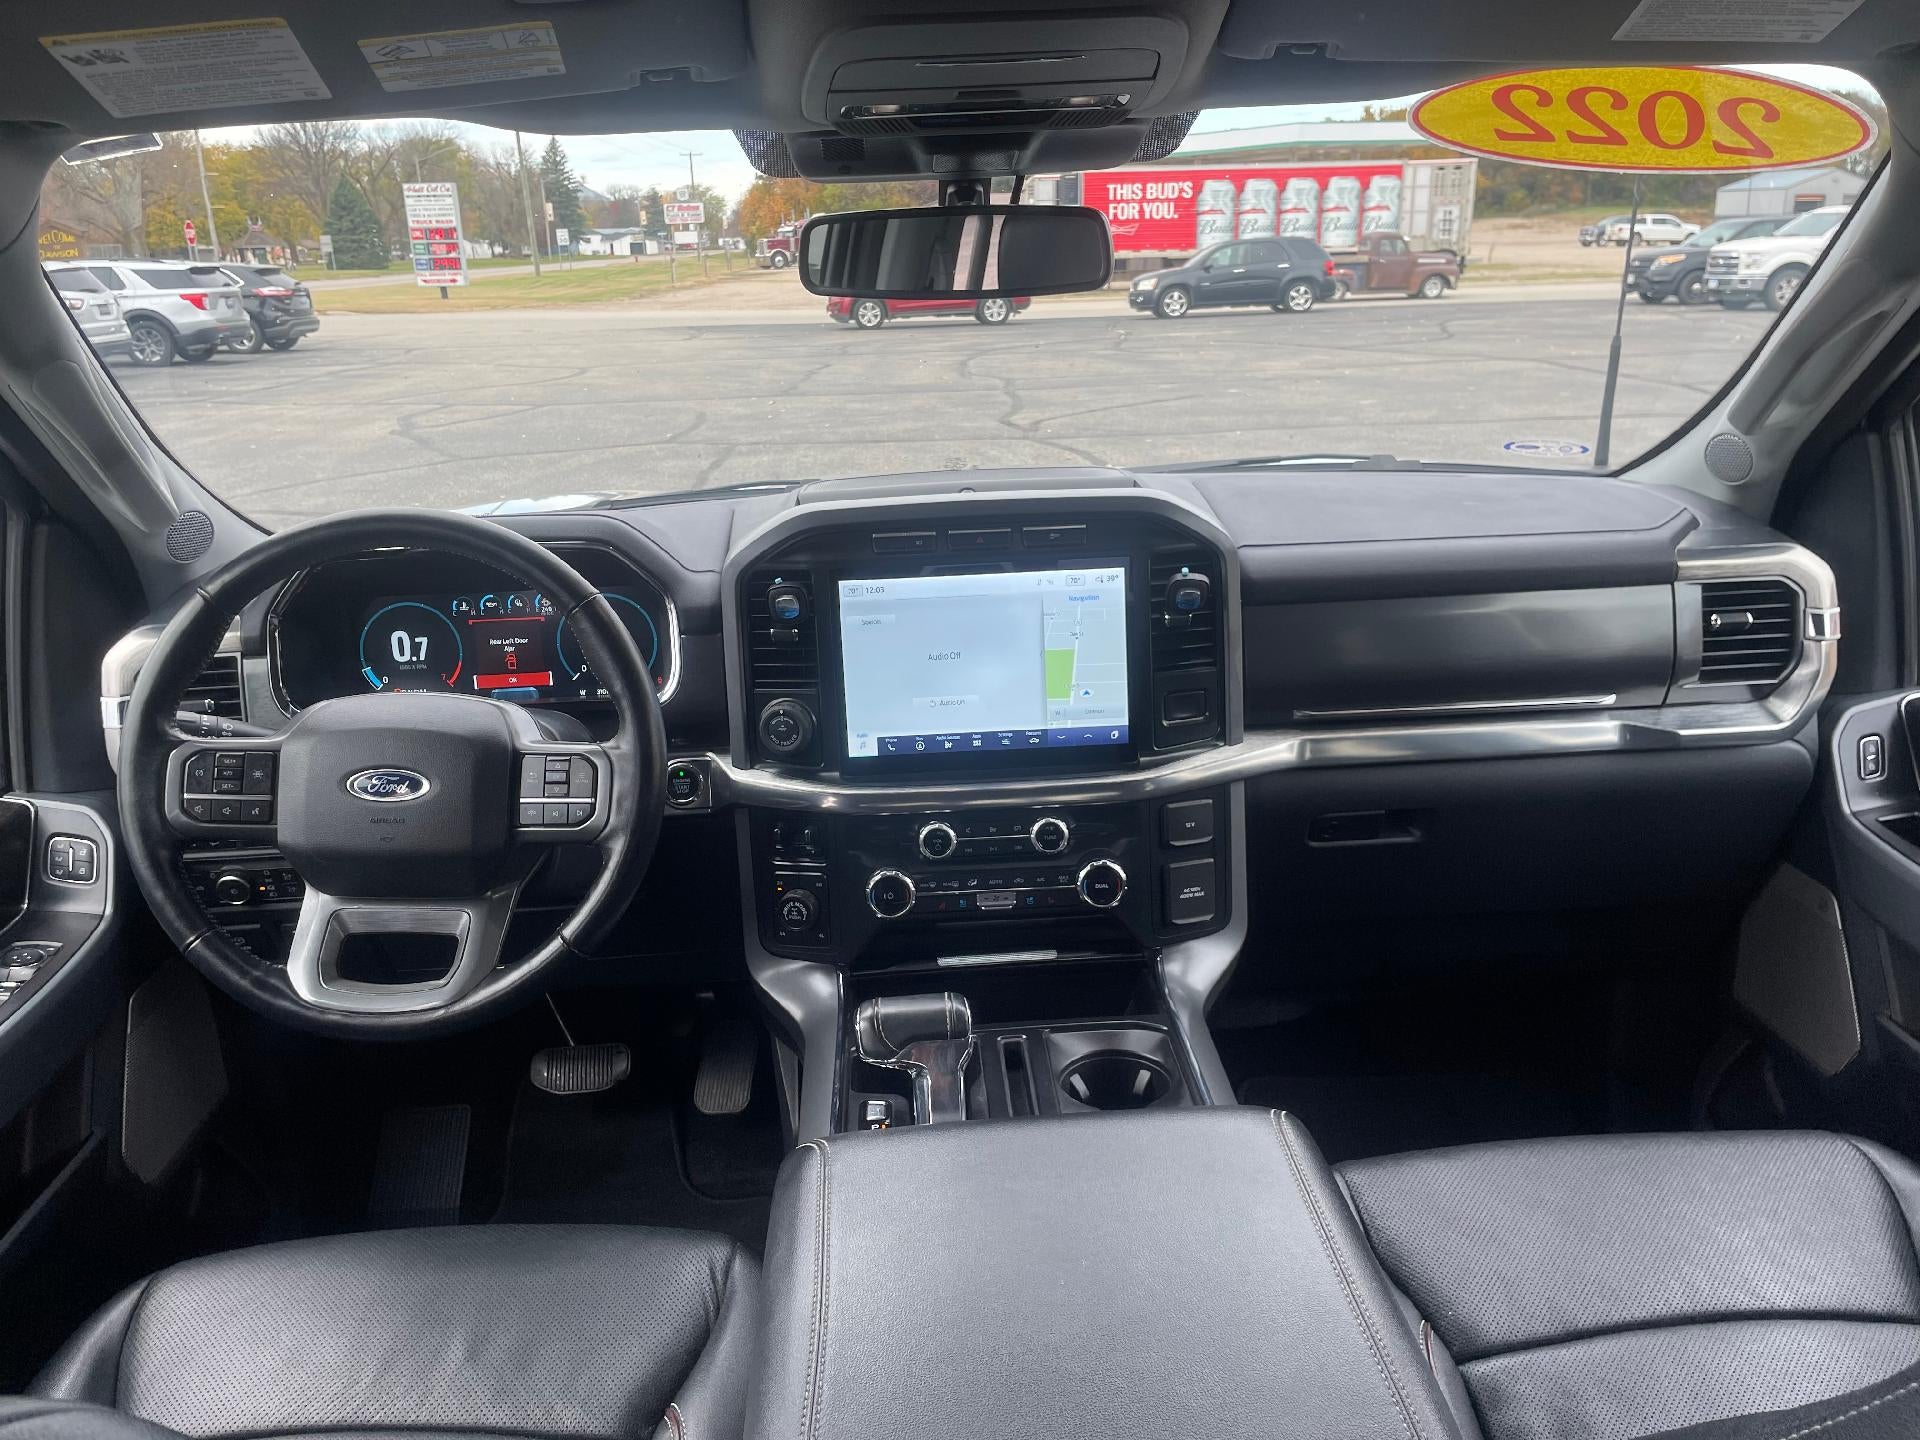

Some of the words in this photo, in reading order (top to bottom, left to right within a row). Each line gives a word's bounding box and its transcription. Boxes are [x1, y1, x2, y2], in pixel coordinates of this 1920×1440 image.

[1106, 183, 1143, 200] THIS
[1145, 181, 1194, 200] BUD'S
[1108, 203, 1140, 220] FOR
[1142, 202, 1179, 220] YOU.
[390, 630, 428, 662] 0.7
[503, 645, 516, 653] Ajar
[928, 653, 949, 661] Audio
[949, 651, 961, 660] Off
[581, 664, 587, 672] 0
[382, 676, 389, 684] 0
[367, 775, 410, 793] Ford
[783, 902, 794, 915] DRIVE
